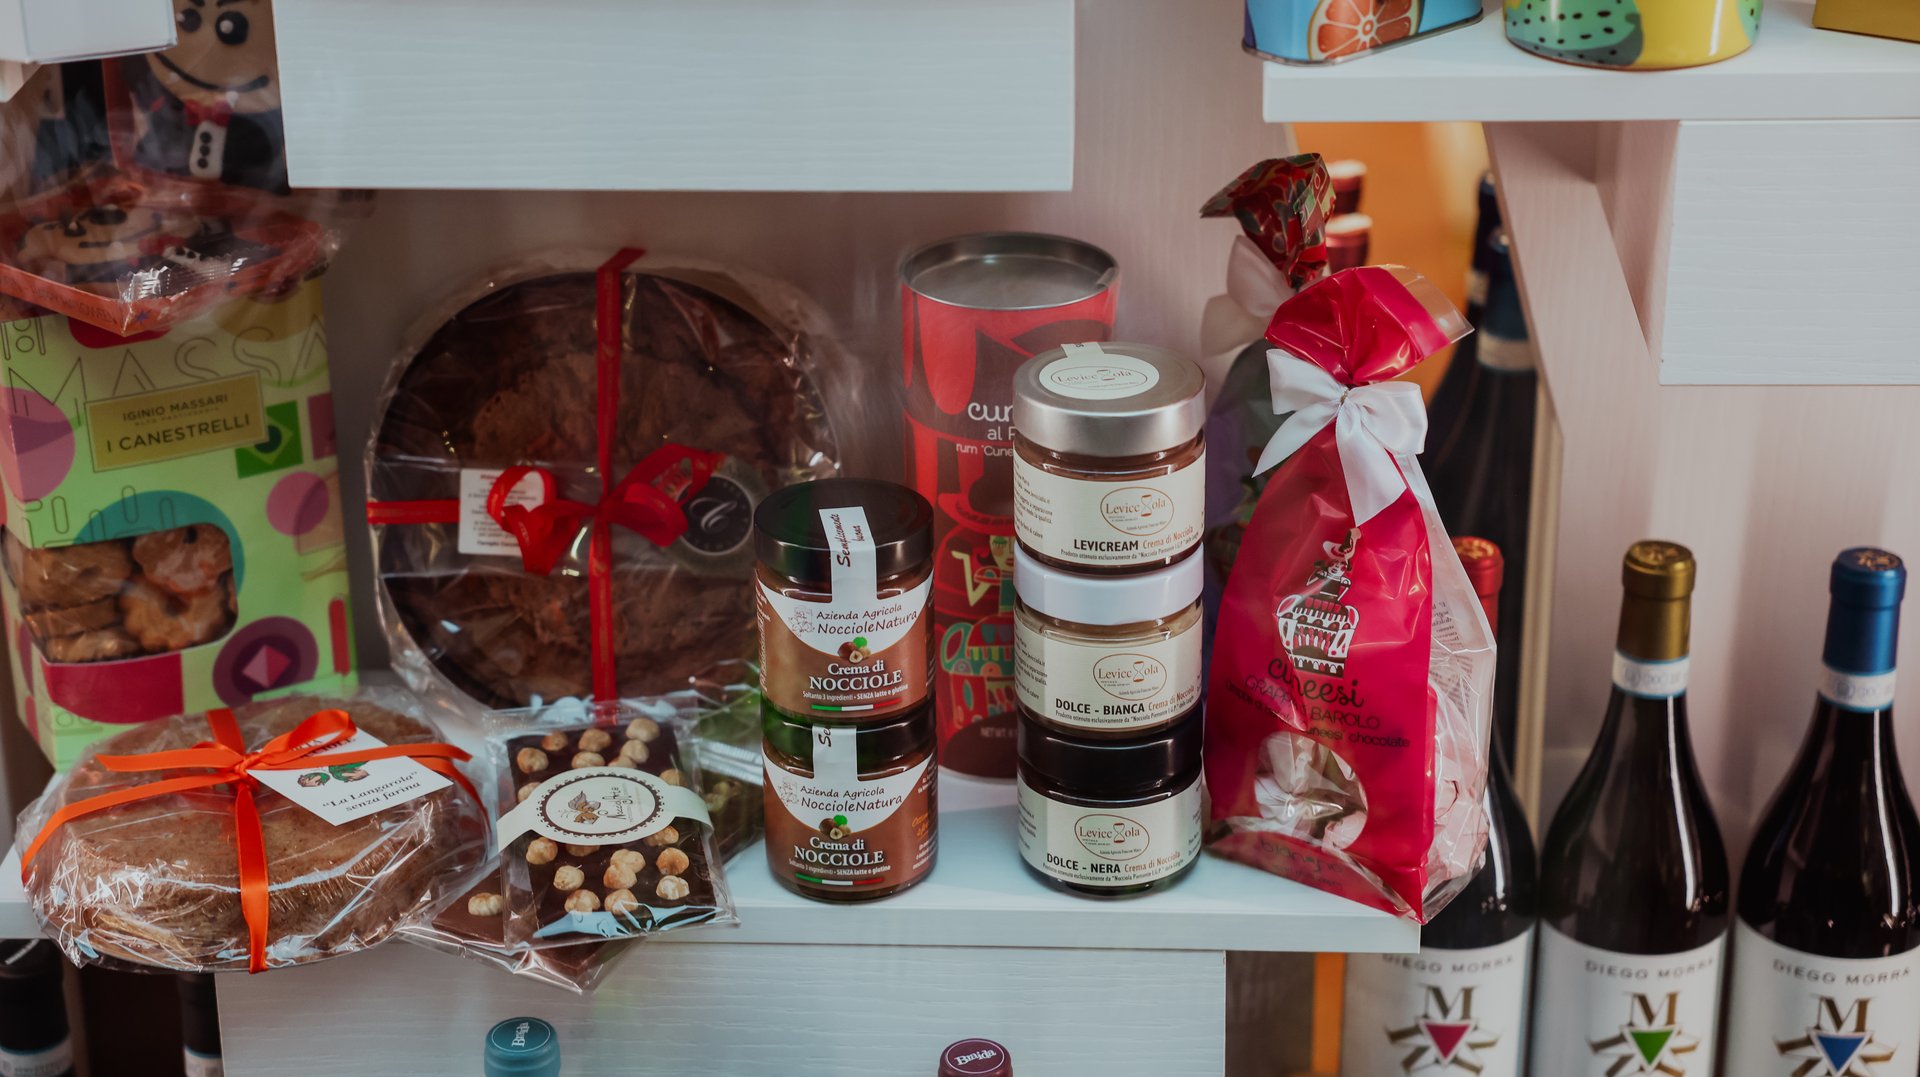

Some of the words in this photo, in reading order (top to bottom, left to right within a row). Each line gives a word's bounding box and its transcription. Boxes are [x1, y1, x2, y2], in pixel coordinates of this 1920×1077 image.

[123, 406, 165, 422] IGINIO
[170, 394, 228, 411] MASSARI
[107, 440, 112, 452] I
[119, 413, 250, 450] CANESTRELLI
[1073, 538, 1139, 552] LEVICREAM
[1143, 538, 1164, 550] Crema
[1165, 533, 1173, 544] di
[1173, 525, 1194, 541] Nocciola
[816, 611, 859, 620] Azienda
[863, 604, 902, 620] Agricola
[817, 610, 917, 635] NoccioleNatura
[828, 663, 870, 675] Crema
[872, 660, 884, 672] di
[809, 669, 903, 691] NOCCIOLE
[857, 691, 874, 699] SENZA
[874, 689, 887, 698] latte
[1055, 698, 1090, 714] DOLCE
[1103, 703, 1144, 716] BIANCA
[1148, 698, 1168, 711] Crema
[1170, 695, 1176, 705] di
[1176, 686, 1195, 702] Nocciola
[1091, 716, 1123, 724] esclusivamente
[1310, 706, 1380, 731] BAROLO
[346, 797, 380, 811] senza
[383, 781, 420, 801] farina
[800, 785, 839, 798] Azienda
[843, 787, 884, 800] Agricola
[801, 795, 902, 812] NoccioleNatura
[810, 836, 850, 850] Crema
[852, 839, 864, 850] di
[794, 845, 884, 866] NOCCIOLE
[1047, 853, 1079, 870] DOLCE
[1090, 863, 1121, 874] NERA
[1124, 864, 1147, 873] Crema
[1148, 860, 1155, 869] di
[1156, 851, 1181, 867] Nocciola
[1074, 872, 1105, 882] esclusivamente
[1382, 955, 1442, 973] DIEGO
[1452, 956, 1514, 974] MORRA
[1585, 959, 1648, 980] DIEGO
[1658, 958, 1713, 978] MORRA
[1773, 959, 1836, 984] DIEGO
[1846, 967, 1911, 985] MORRA
[954, 1049, 997, 1066] Braida
